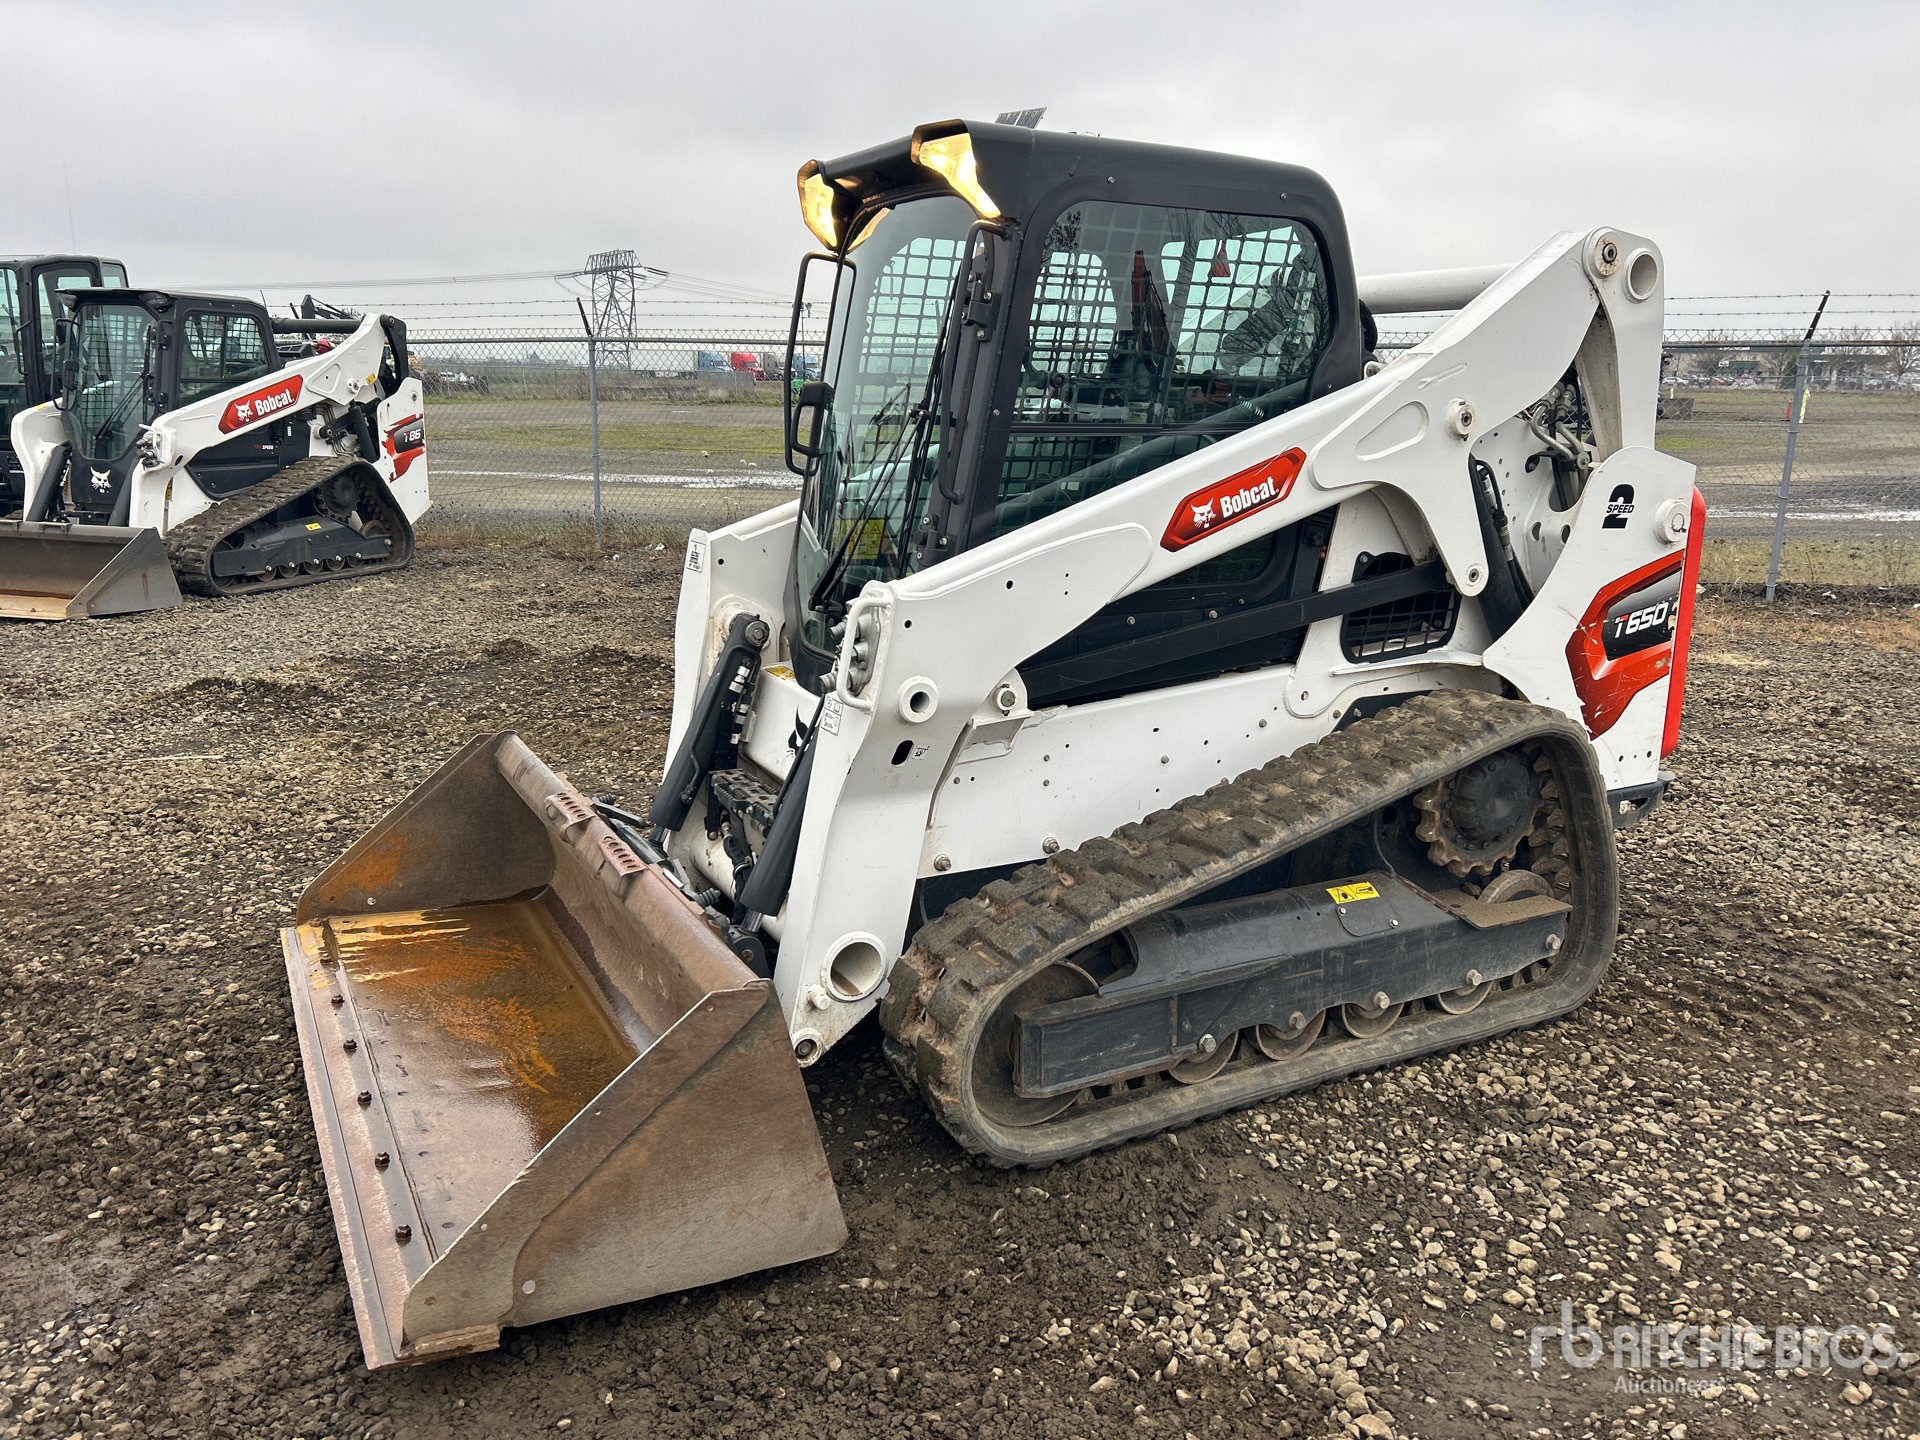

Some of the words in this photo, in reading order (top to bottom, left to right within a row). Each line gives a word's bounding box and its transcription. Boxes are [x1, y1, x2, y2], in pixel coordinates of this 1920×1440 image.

[255, 388, 295, 416] Bobcat
[403, 428, 422, 443] T86
[1219, 475, 1280, 519] Bobcat
[1602, 483, 1635, 529] 2
[1606, 504, 1635, 514] SPEED
[1614, 601, 1669, 639] T650
